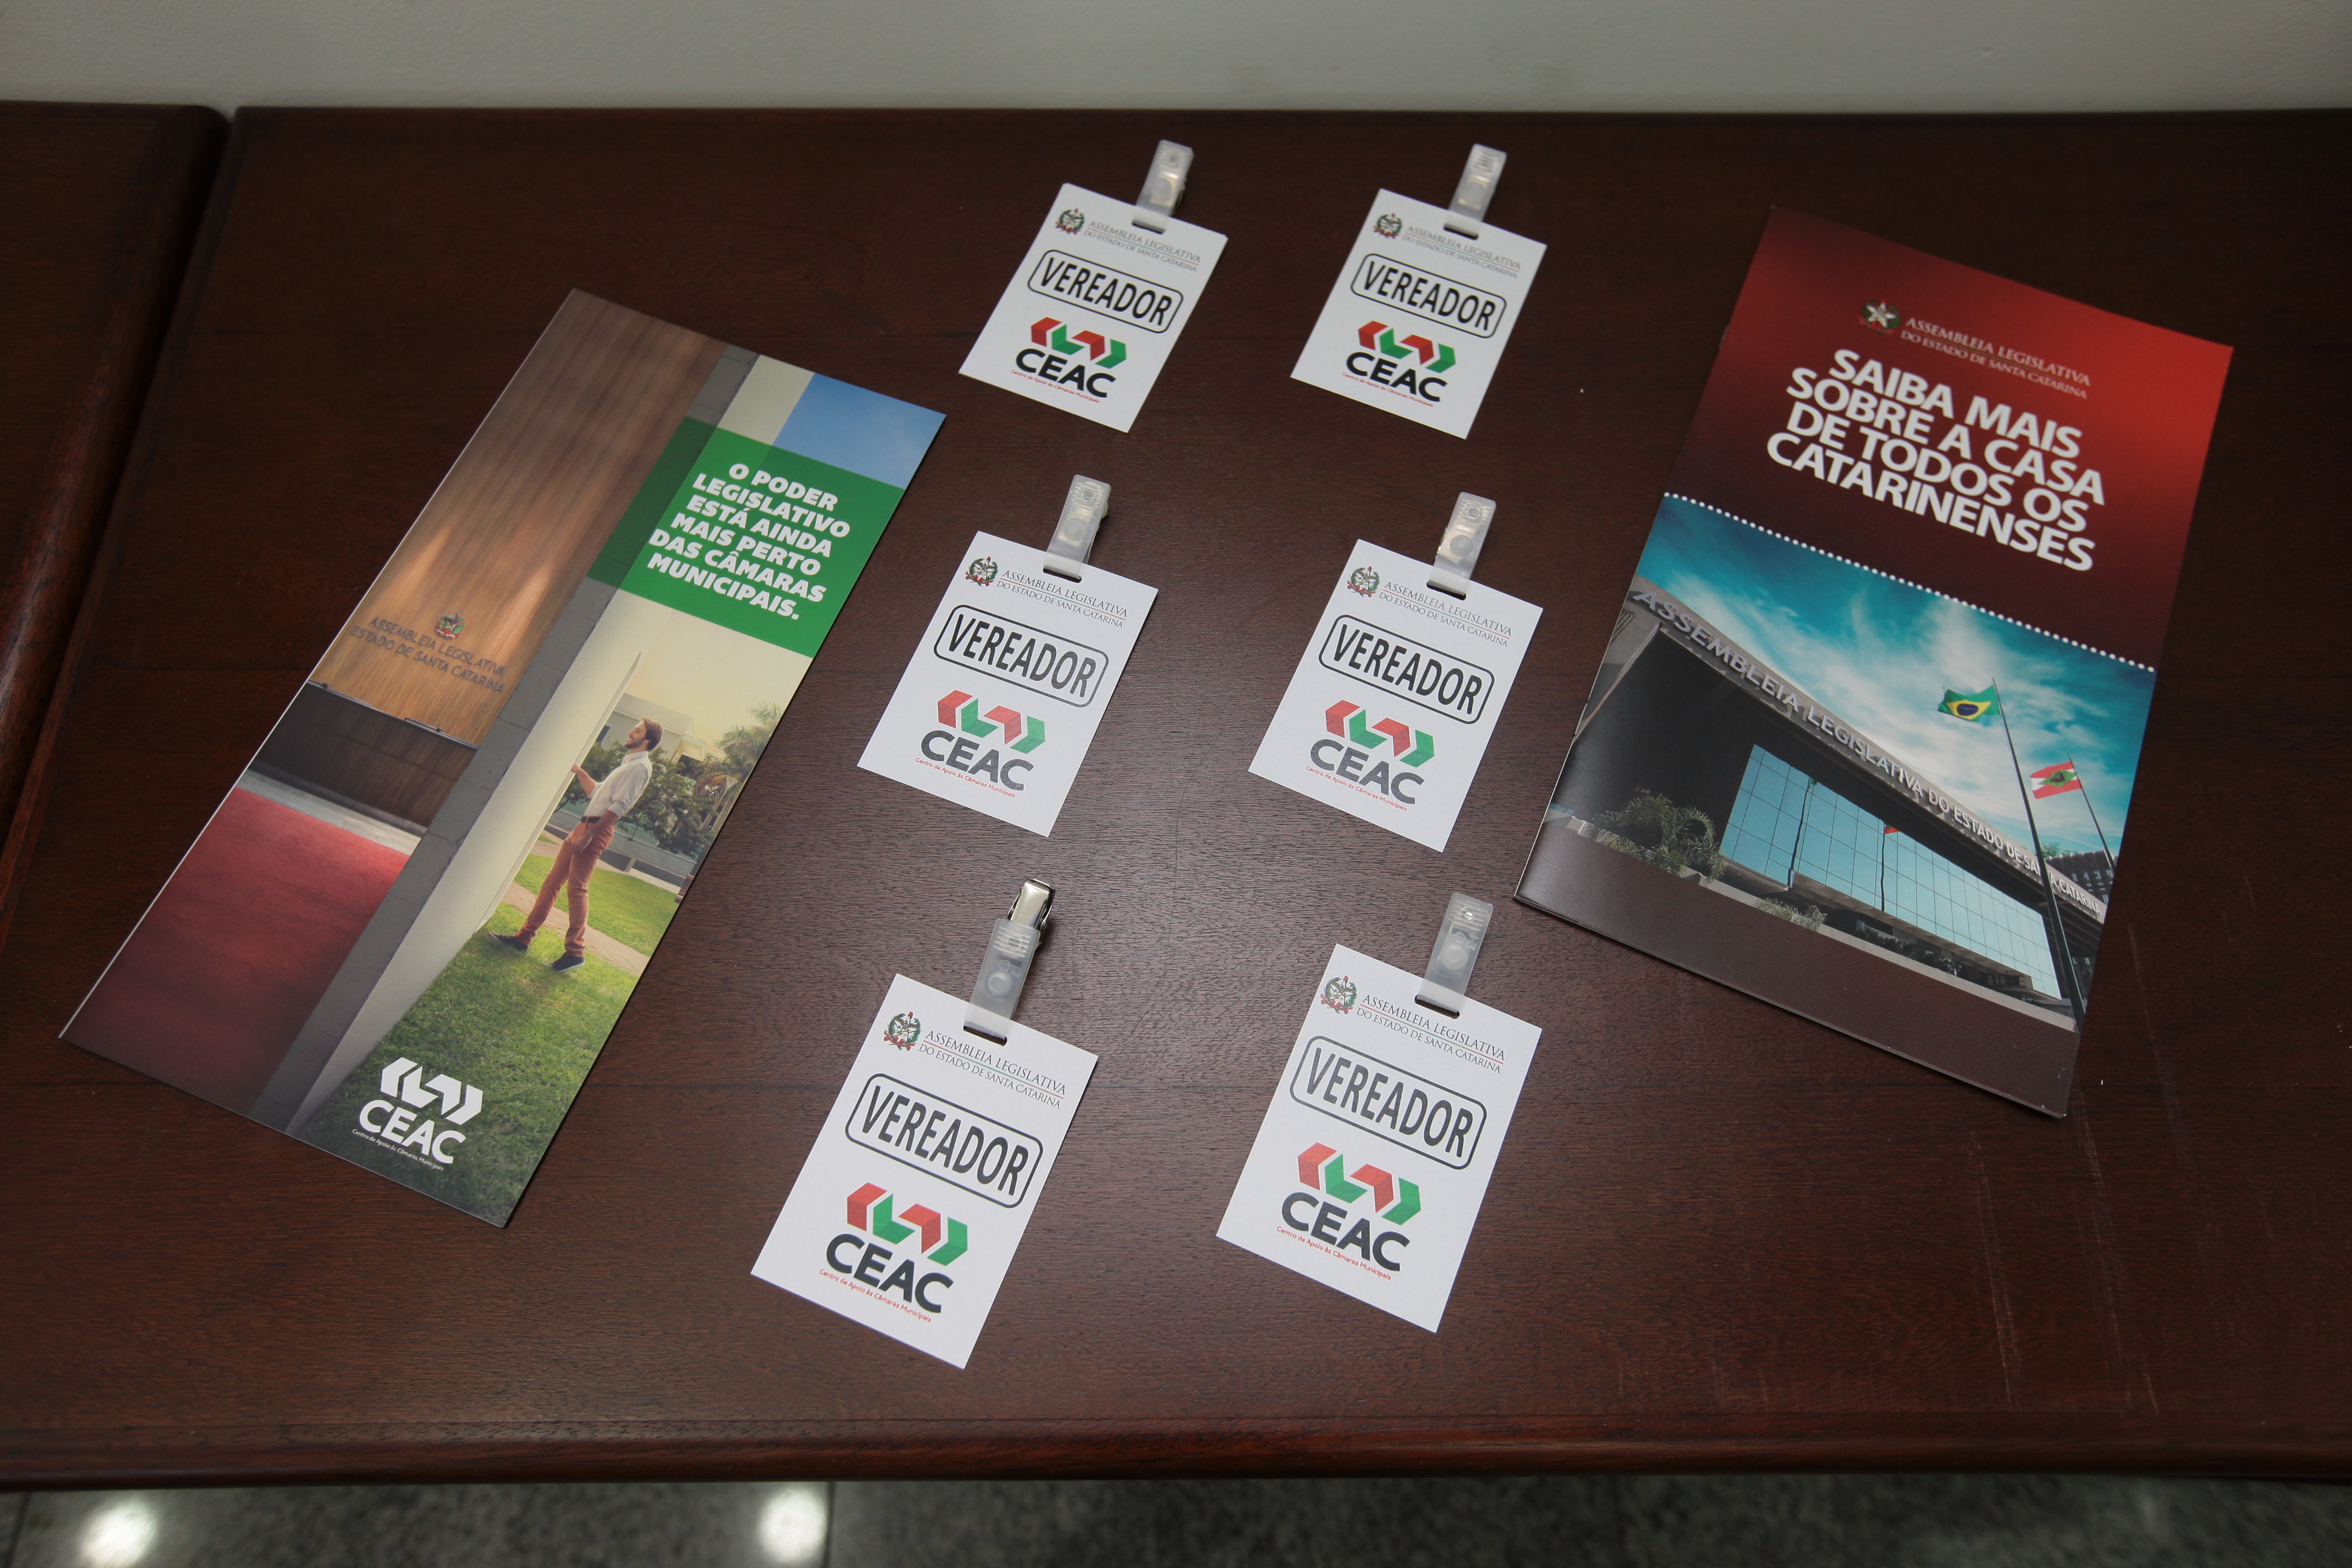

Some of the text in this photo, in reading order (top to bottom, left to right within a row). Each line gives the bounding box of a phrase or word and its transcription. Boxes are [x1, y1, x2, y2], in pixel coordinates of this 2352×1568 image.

[1041, 257, 1173, 326] VEREADOR
[1363, 260, 1496, 331] VEREADOR
[1016, 348, 1117, 398] CEAC
[1346, 352, 1448, 402] CEAC
[1901, 330, 2088, 399] DO ESTADO DE SANTA CATARINA
[1905, 316, 2090, 387] ASSEMBLEIA LEGISLATIVA
[1786, 367, 2105, 506] SOBRE A CASA
[1828, 349, 2082, 459] SAIBA MAIS
[729, 463, 838, 511] O PODER
[1786, 401, 2090, 533] DE TODOS OS
[686, 494, 832, 558] ESTÁ AINDA
[692, 473, 850, 538] LEGISLATIVO
[1766, 432, 2095, 571] CATARINENSES
[649, 529, 827, 602] DAS CÂMARAS
[670, 512, 821, 576] MAIS PERTO
[647, 552, 800, 621] MUNICIPAIS.
[996, 579, 1124, 628] DO ESTADO DE SANTA CATARINA
[1002, 569, 1128, 618] ASSEMBLEIA LEGISLATIVA
[1384, 582, 1512, 638] ASSEMBLEIA LEGISLATIVA
[370, 617, 505, 677] ASSEMBLEIA LEGISLATIVA
[1379, 591, 1507, 649] DO ESTADO DE SANTA CATARINA
[350, 627, 504, 692] ESTADO DE SANTA CATARINA
[948, 613, 1096, 698] VEREADOR
[1333, 624, 1483, 715] VEREADOR
[921, 730, 1034, 791] CEAC
[1310, 739, 1424, 804] CEAC
[1633, 591, 1799, 712] ASSEMBLEIA
[1807, 705, 1923, 797] LEGISLATIVA
[1928, 787, 1950, 813] DO
[1953, 806, 2003, 849] ESTADO
[2006, 842, 2022, 864] DE
[2059, 880, 2102, 915] CATARINA
[1356, 1007, 1501, 1074] DO ESTADO DE SANTA CATARINA
[1362, 994, 1505, 1061] ASSEMBLEIA LEGISLATIVA
[919, 1043, 1061, 1109] DO ESTADO DE SANTA CATARINA
[925, 1030, 1066, 1096] ASSEMBLEIA LEGISLATIVA
[359, 1099, 466, 1164] CEAC
[1306, 1047, 1473, 1158] VEREADOR
[862, 1085, 1029, 1196] VEREADOR
[1276, 1226, 1297, 1239] Centro
[1306, 1239, 1324, 1250] Apoio
[1332, 1250, 1359, 1266] Câmaras
[1359, 1262, 1392, 1280] Municipais
[1281, 1192, 1411, 1272] CEAC
[819, 1268, 839, 1281] Centro
[848, 1281, 865, 1293] Apoio
[874, 1292, 900, 1309] Câmaras
[900, 1304, 932, 1323] Municipais
[826, 1233, 954, 1314] CEAC
